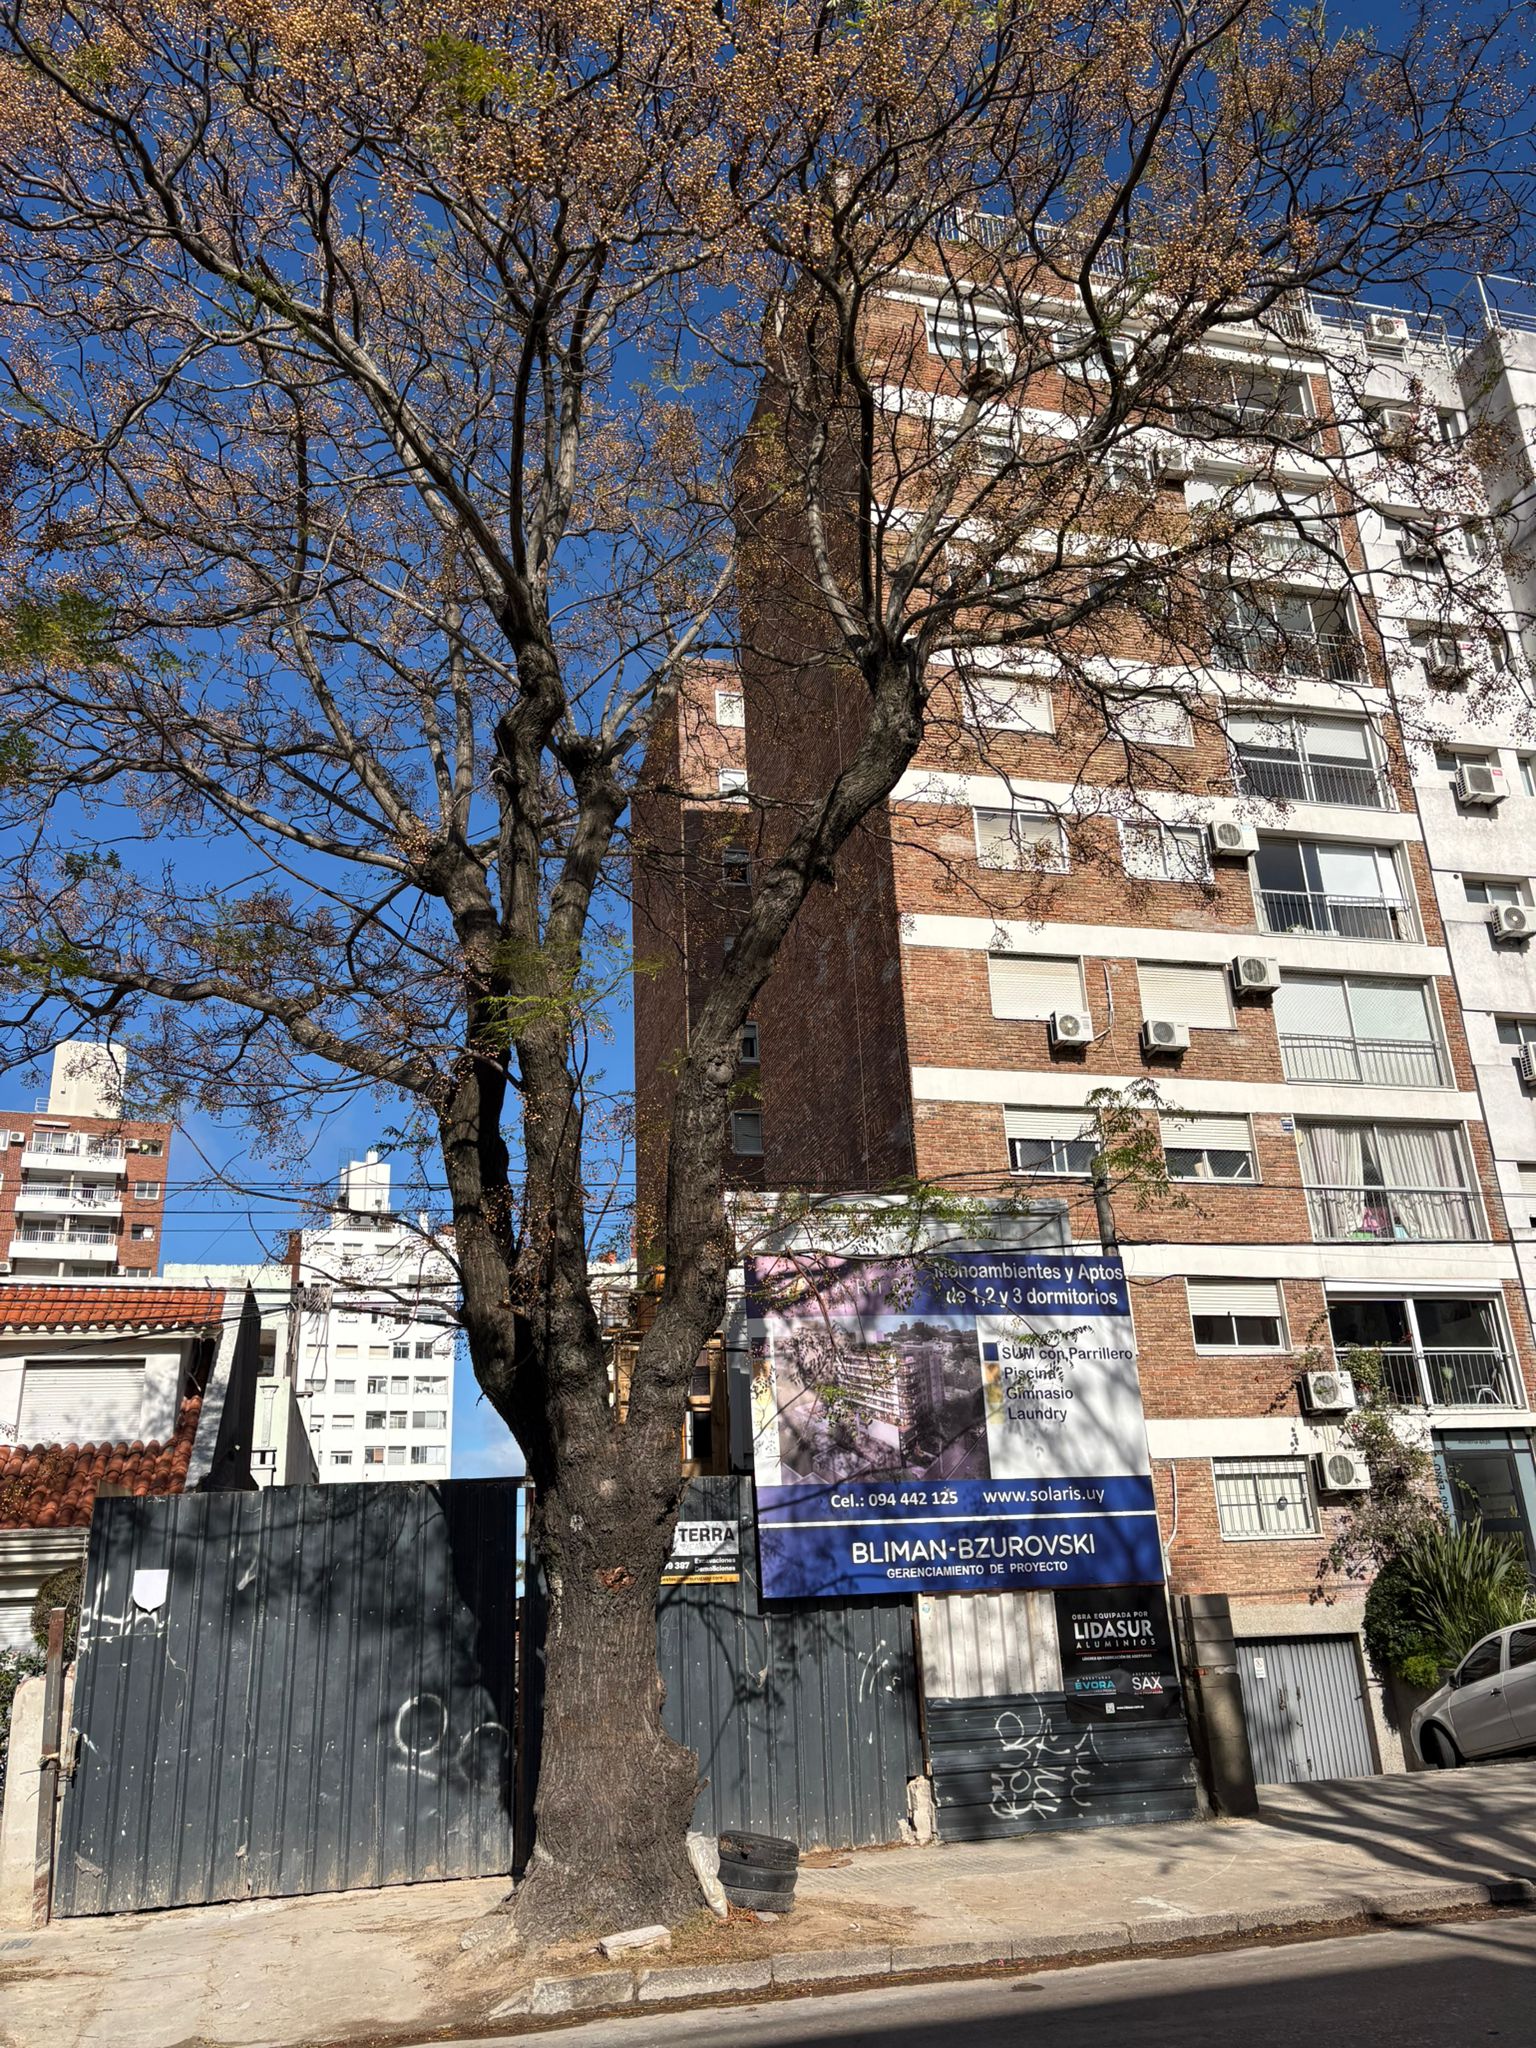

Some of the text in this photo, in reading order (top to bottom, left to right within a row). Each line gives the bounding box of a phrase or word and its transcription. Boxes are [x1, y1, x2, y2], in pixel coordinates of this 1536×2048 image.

[934, 1262, 1123, 1284] Monoambientes y Aptos
[973, 1286, 996, 1307] 1,2
[1000, 1293, 1009, 1307] y
[1013, 1287, 1022, 1304] 3
[1026, 1288, 1118, 1305] dormitorios
[1002, 1346, 1133, 1360] SUM con Parrillero
[1004, 1366, 1056, 1380] Piscina
[1006, 1386, 1074, 1400] Gimnasio
[1008, 1407, 1067, 1423] Laundry
[831, 1486, 1105, 1508] Cel.: 094 442 125 www.solaris.uy
[678, 1527, 735, 1542] TERRA
[852, 1533, 1095, 1564] BLIMAN-BZUROVSKI
[886, 1560, 1068, 1579] GERENCIAMIENTO DE PROYECTO
[1094, 1611, 1131, 1619] EQUIPADA
[1074, 1620, 1154, 1640] LIDASUR
[1076, 1638, 1156, 1649] ALUMINIOS
[1074, 1676, 1163, 1691] ÉVORA SAX
